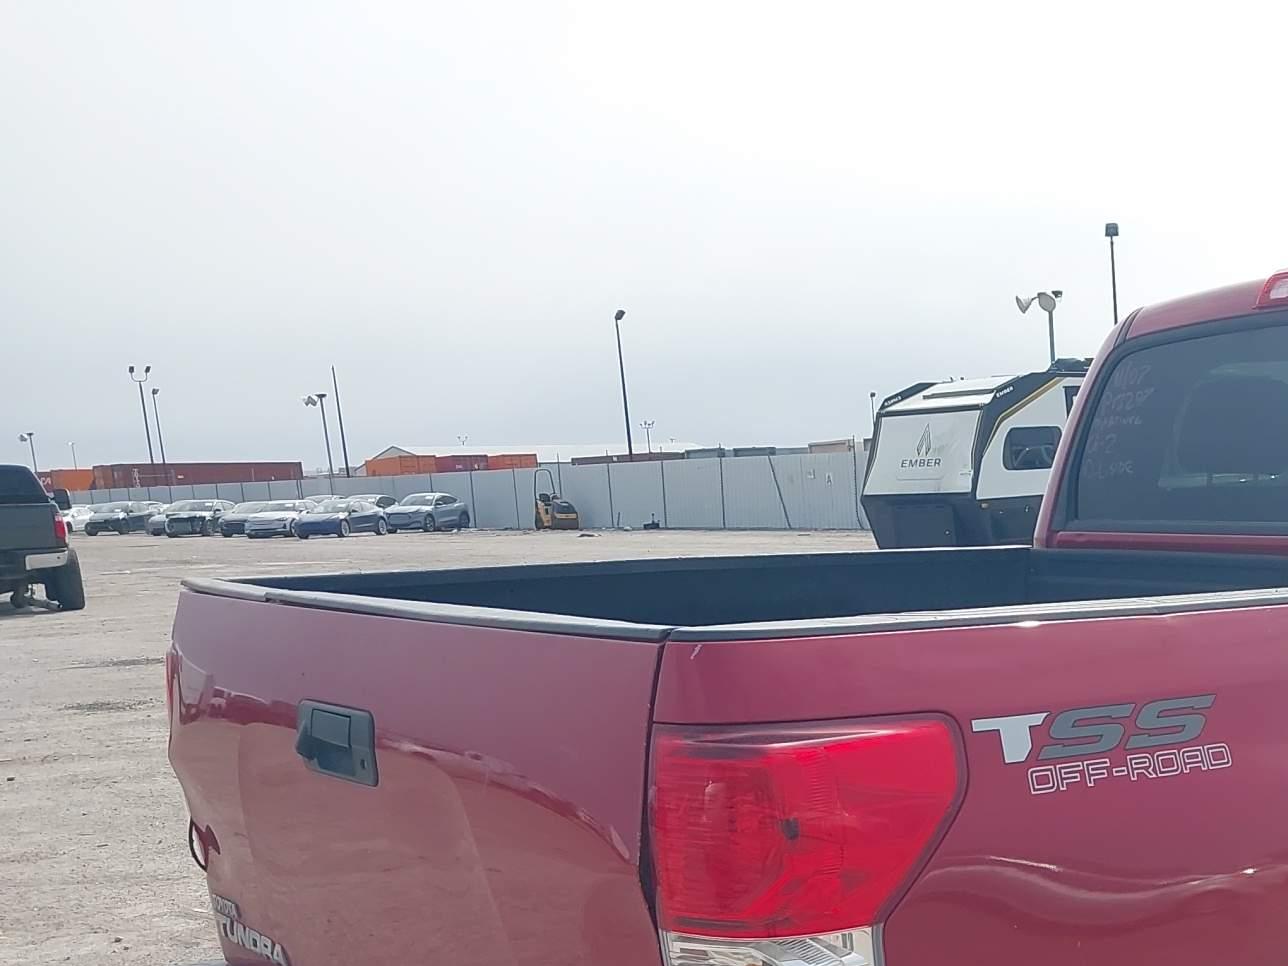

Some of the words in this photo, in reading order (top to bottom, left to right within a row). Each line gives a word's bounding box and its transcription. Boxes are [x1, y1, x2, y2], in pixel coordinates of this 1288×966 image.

[900, 457, 942, 469] EMBER
[971, 694, 1217, 764] TSS
[1028, 743, 1232, 795] OFF-ROAD
